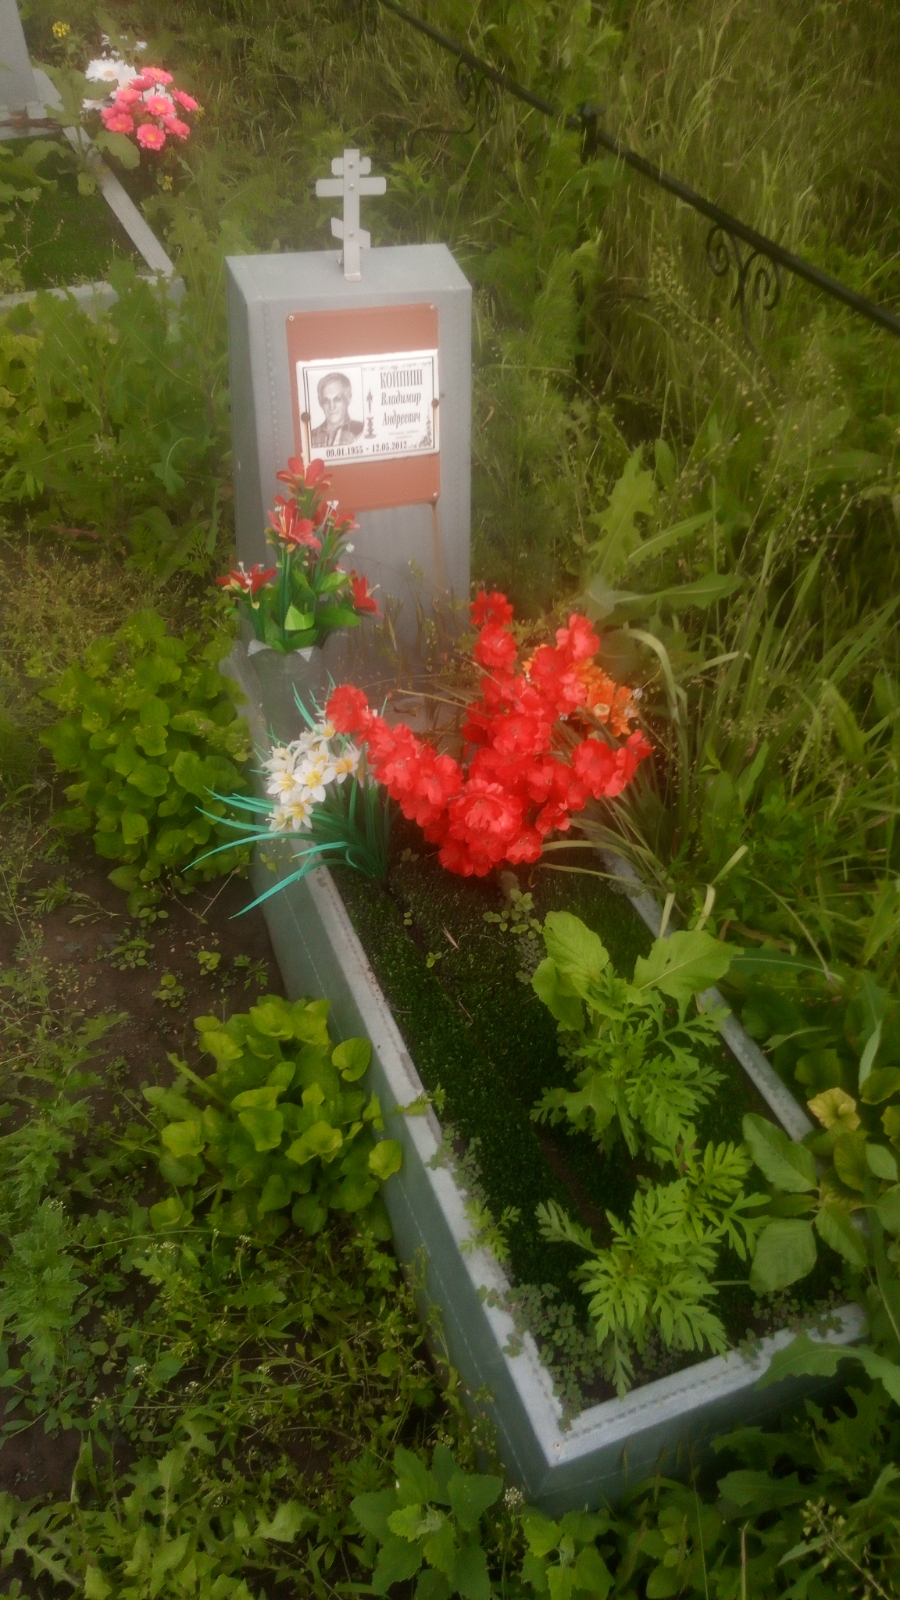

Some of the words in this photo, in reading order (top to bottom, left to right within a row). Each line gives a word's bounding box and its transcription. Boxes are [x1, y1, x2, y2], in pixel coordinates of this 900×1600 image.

[381, 390, 422, 406] Владимир
[382, 409, 421, 428] Андреевич
[372, 440, 408, 452] 12.05.2012
